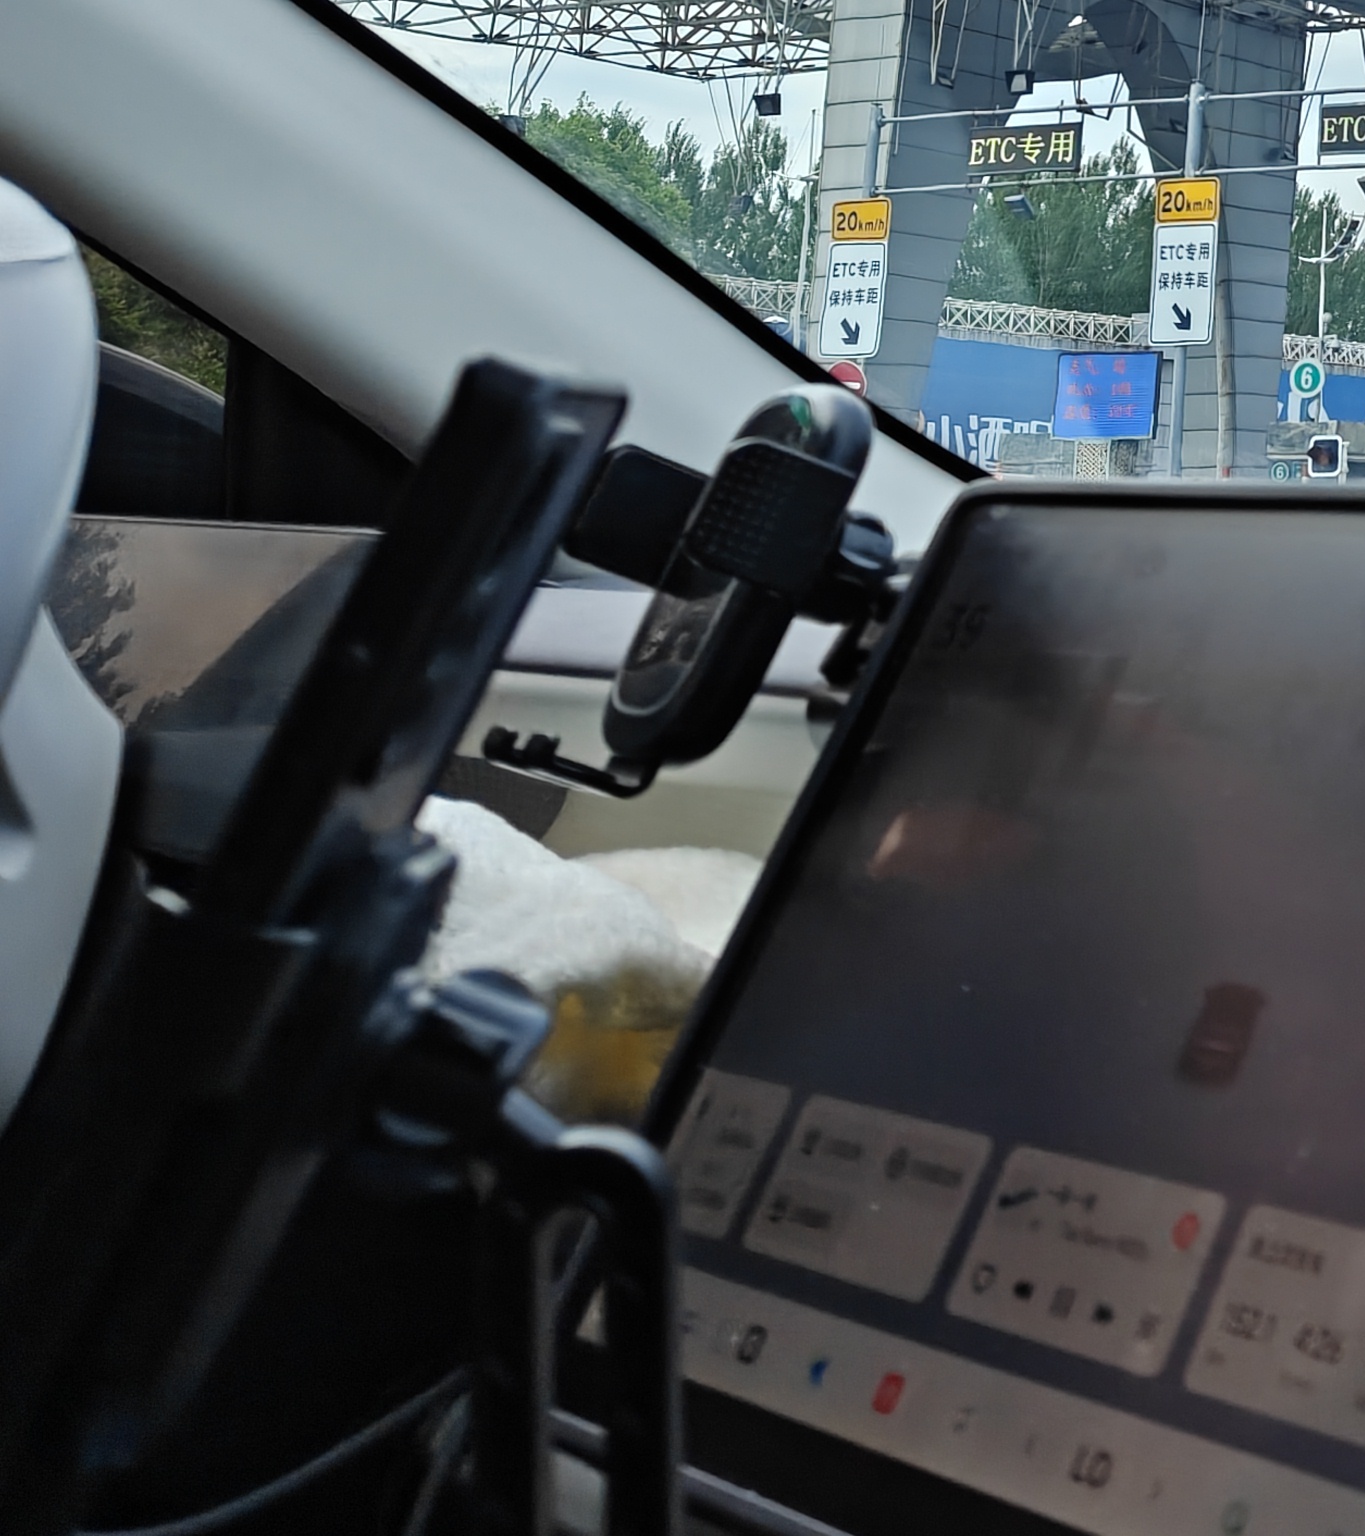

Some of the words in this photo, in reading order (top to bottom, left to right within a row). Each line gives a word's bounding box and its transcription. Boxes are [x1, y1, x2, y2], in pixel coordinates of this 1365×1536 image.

[968, 129, 1075, 166] ETC专用
[1161, 190, 1213, 212] 20km/h
[836, 211, 884, 231] 20km/h
[1160, 243, 1209, 260] ETC专用
[832, 260, 880, 277] ETC专用
[1159, 272, 1209, 290] 保持车距
[829, 288, 878, 306] 保持车距
[1301, 369, 1313, 390] 6
[1275, 467, 1285, 479] 6
